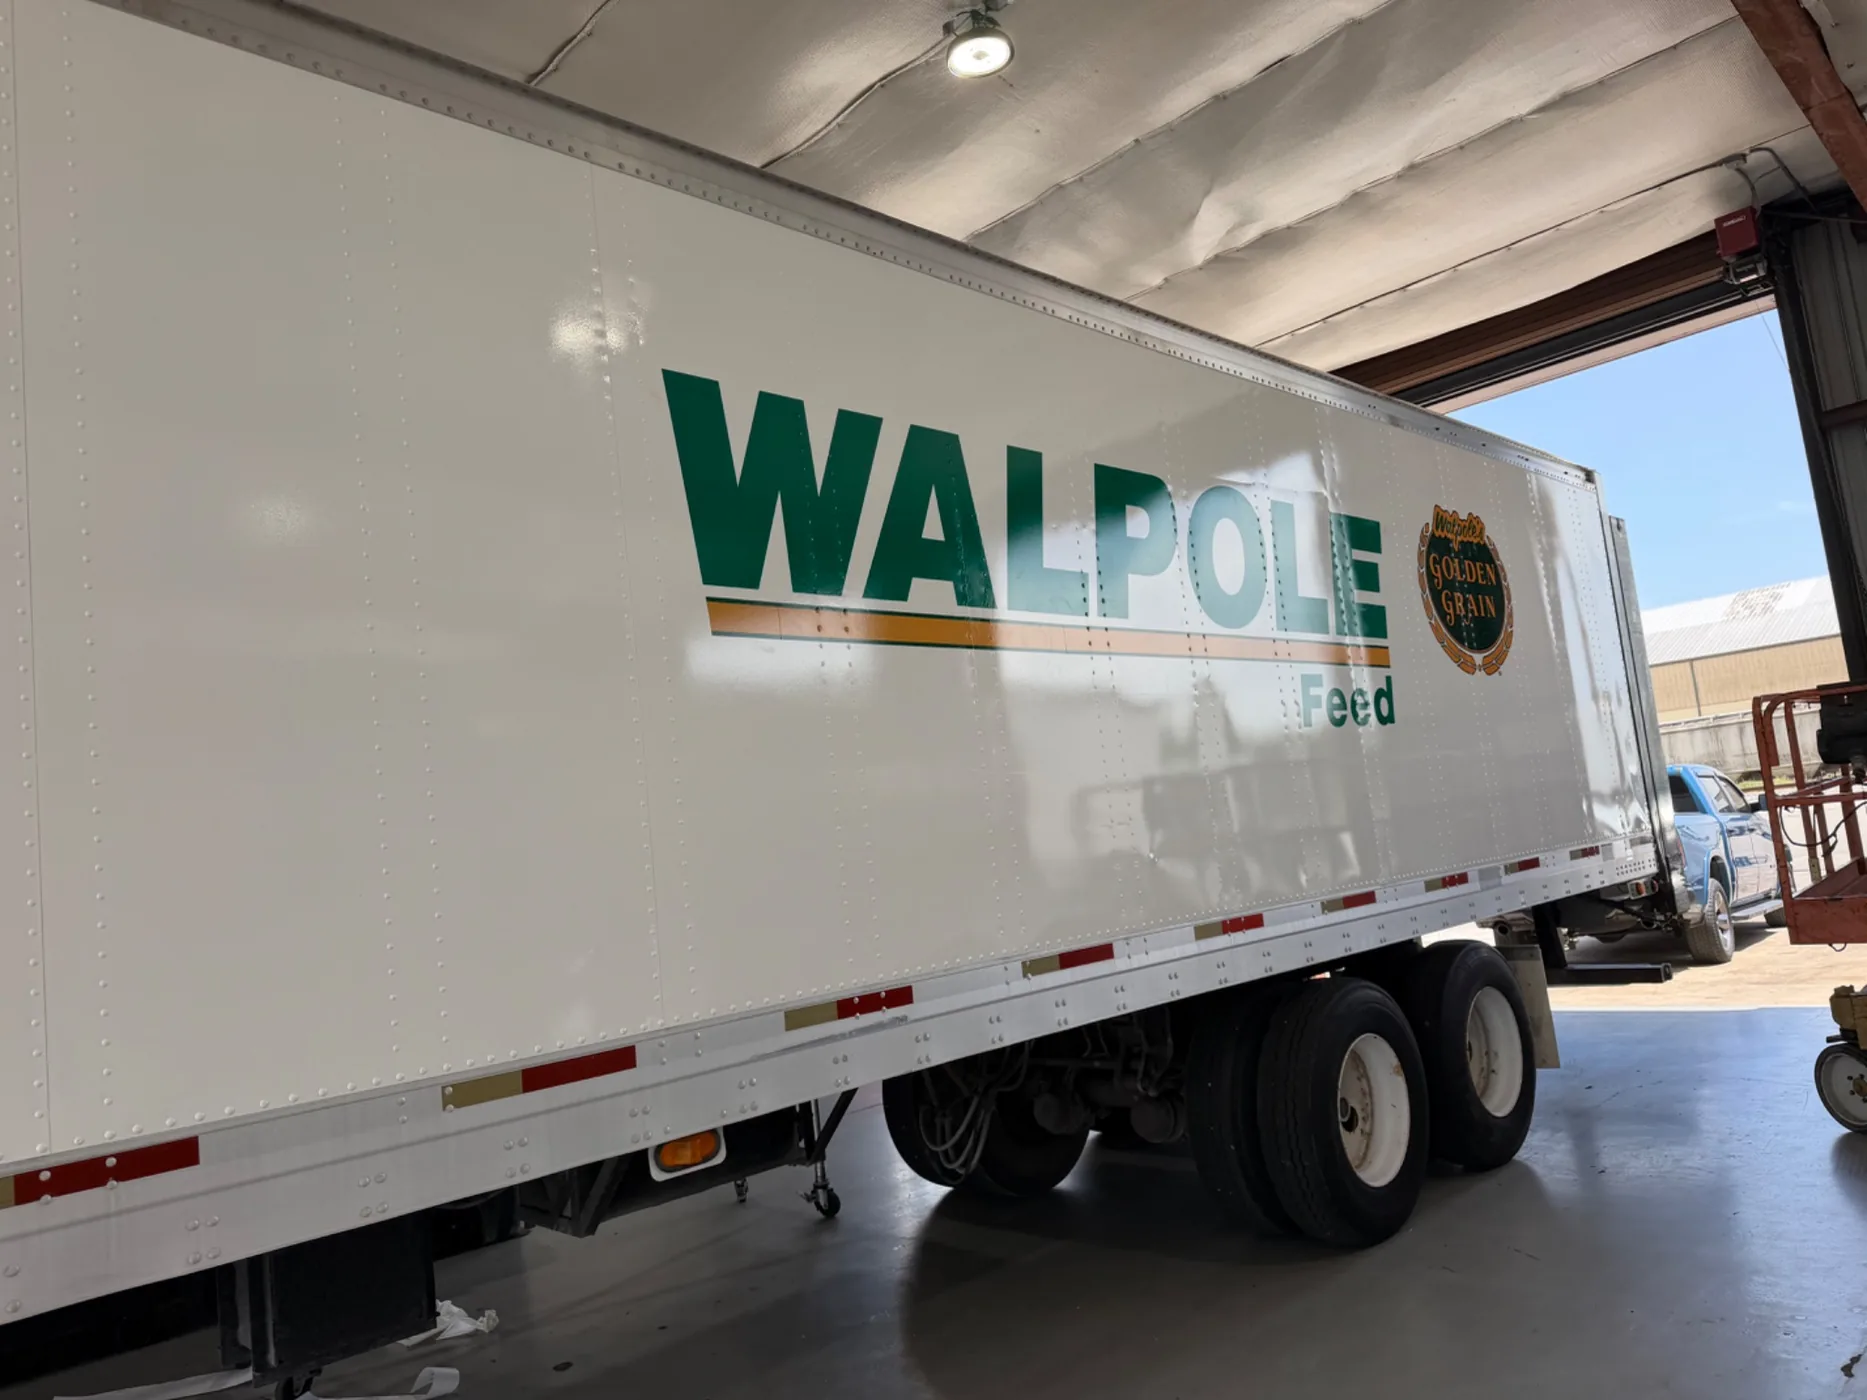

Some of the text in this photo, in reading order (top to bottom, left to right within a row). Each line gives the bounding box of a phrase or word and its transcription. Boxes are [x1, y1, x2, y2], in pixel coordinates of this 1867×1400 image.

[662, 369, 1388, 639] WALPOLE
[1434, 507, 1485, 548] Walpole's
[1429, 553, 1497, 589] GOLDEN
[1441, 589, 1497, 626] GRAIN
[1300, 673, 1396, 728] Feed
